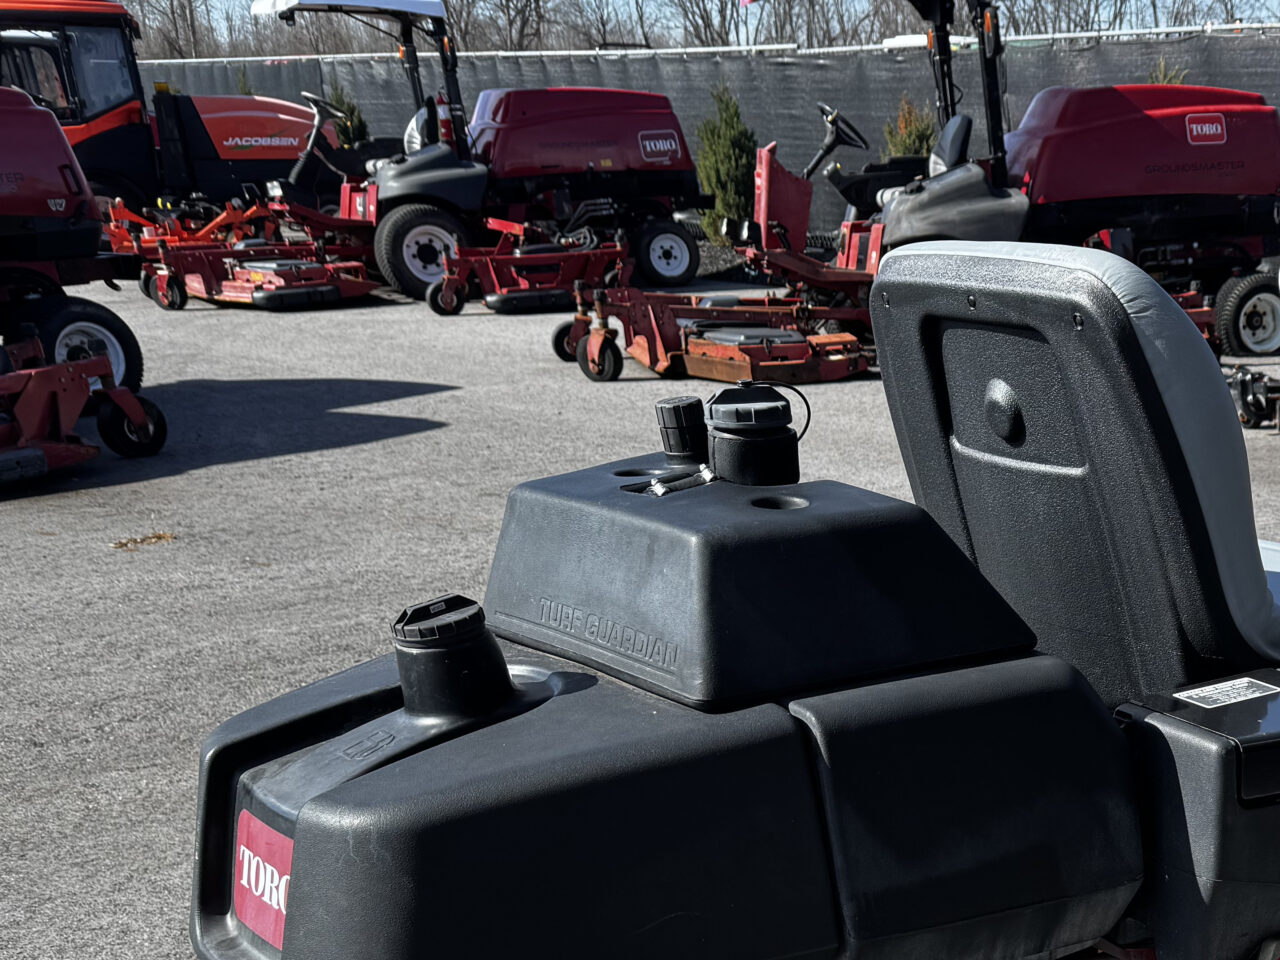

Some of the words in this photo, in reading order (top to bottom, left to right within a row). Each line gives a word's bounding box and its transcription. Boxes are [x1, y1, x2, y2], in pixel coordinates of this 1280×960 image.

[1190, 122, 1222, 136] TORO
[223, 136, 299, 146] JACOBSEN
[643, 139, 676, 152] TORO
[540, 597, 583, 633] TURF
[585, 613, 680, 670] GUARDIAN
